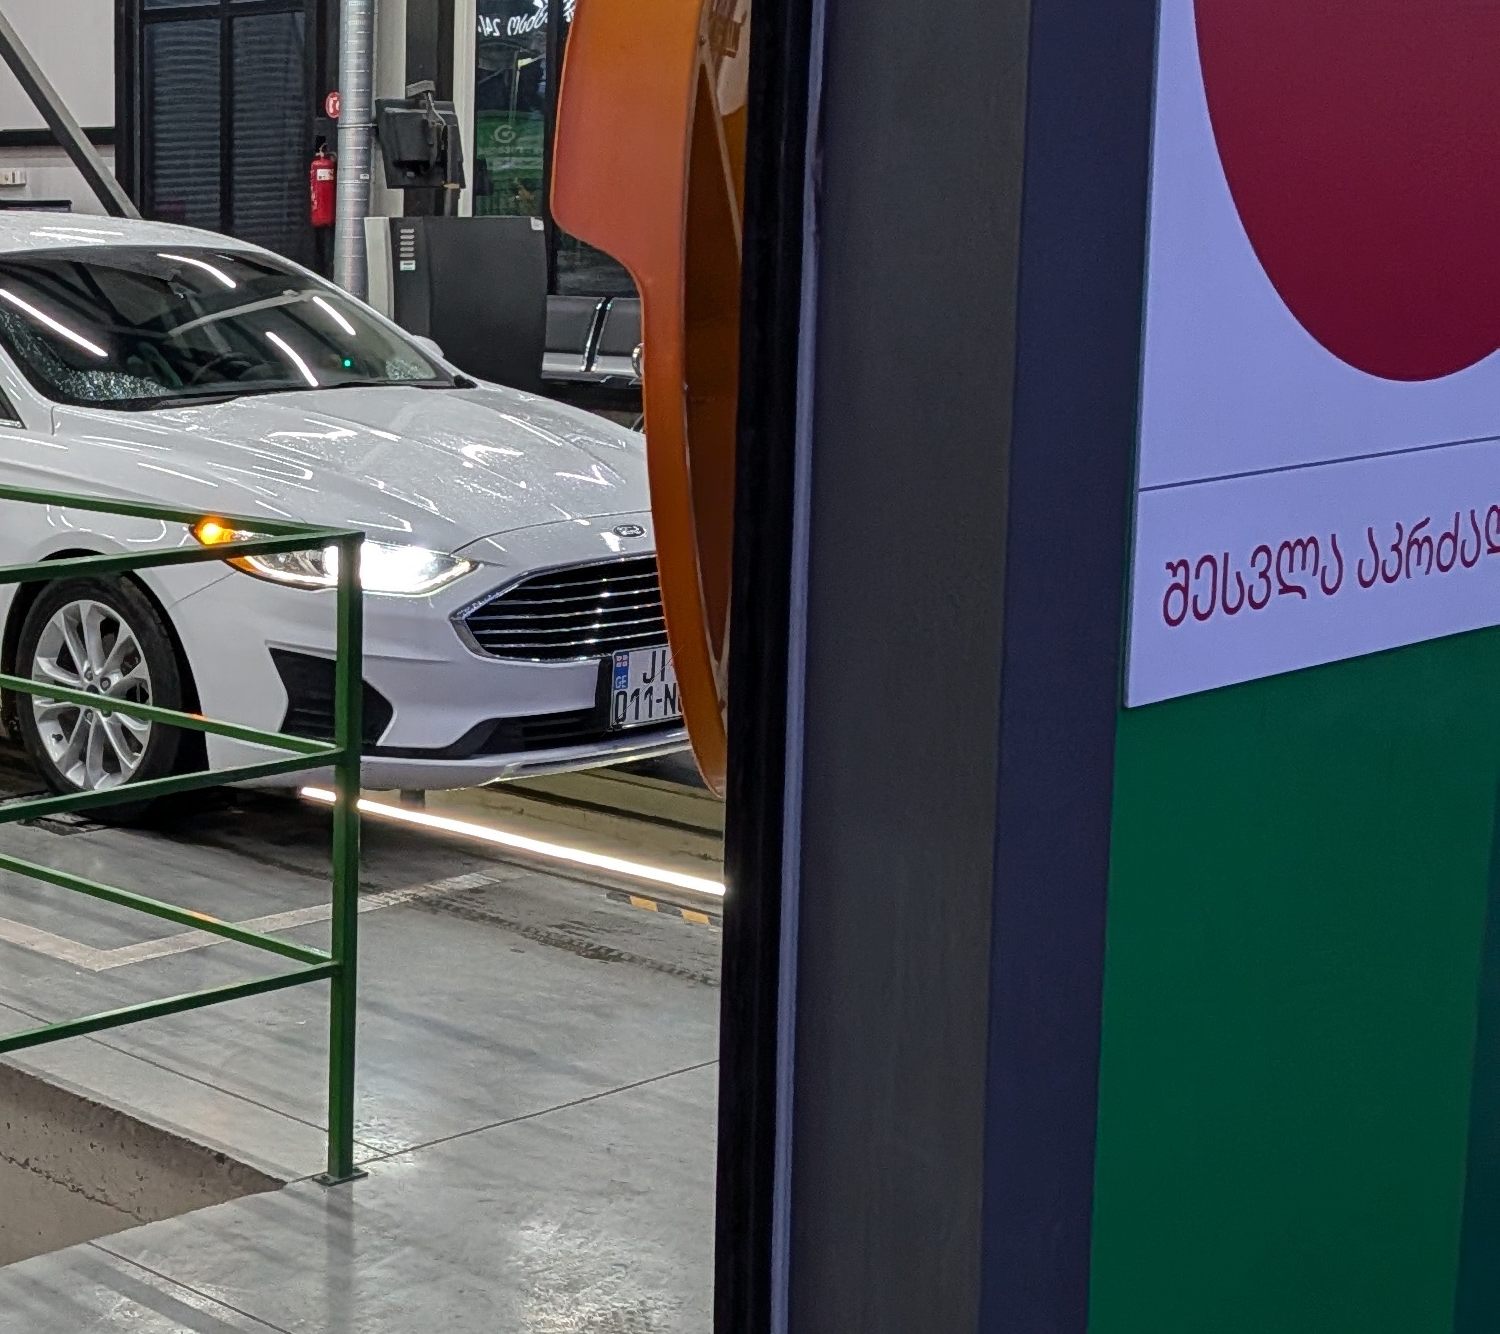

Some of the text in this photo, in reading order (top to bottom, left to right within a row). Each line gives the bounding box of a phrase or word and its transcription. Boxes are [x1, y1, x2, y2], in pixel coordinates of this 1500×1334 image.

[1162, 533, 1344, 627] შესვლა
[615, 674, 628, 689] GE
[642, 649, 667, 684] JI
[614, 682, 683, 724] 011-N
